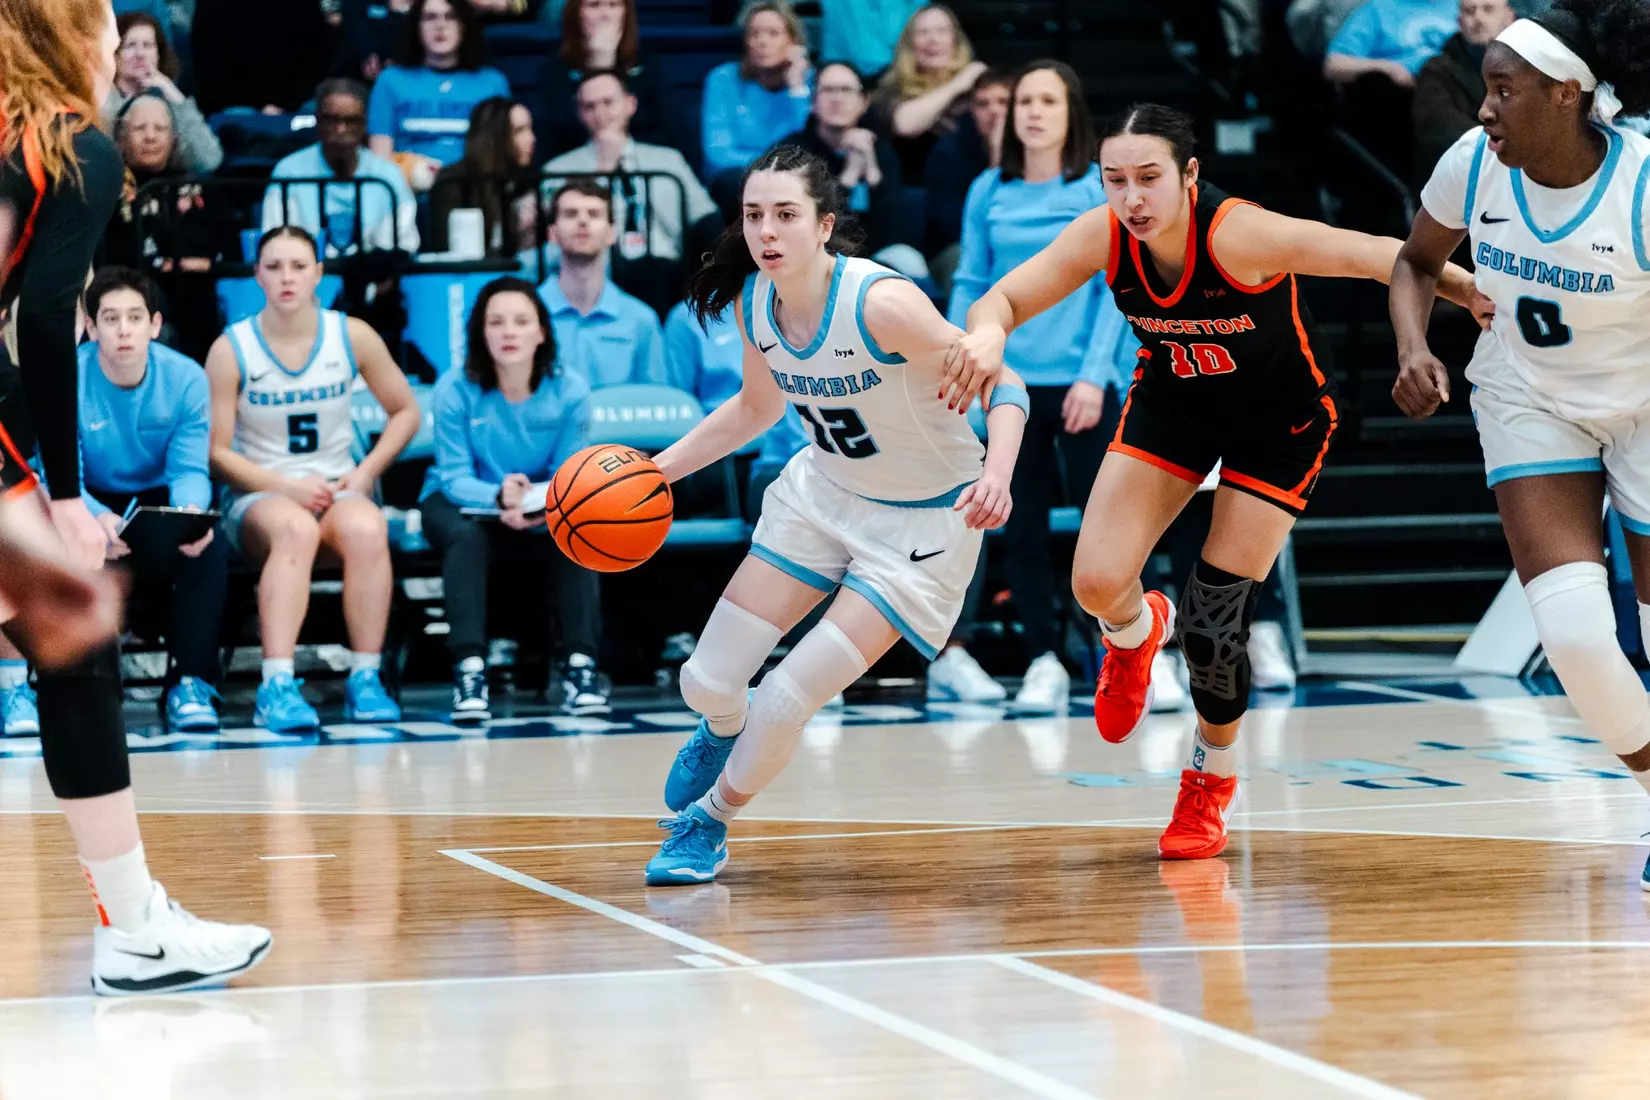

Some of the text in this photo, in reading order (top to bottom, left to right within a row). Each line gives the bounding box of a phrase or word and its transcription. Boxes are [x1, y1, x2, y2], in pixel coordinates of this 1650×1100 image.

[1476, 241, 1615, 293] COLUMBIA
[1591, 243, 1606, 254] Ivy
[1514, 295, 1573, 348] 0
[834, 348, 849, 359] Ivy
[1160, 340, 1237, 378] 10
[287, 412, 318, 454] 5
[592, 404, 693, 422] OLUMBIA
[793, 401, 881, 459] 12
